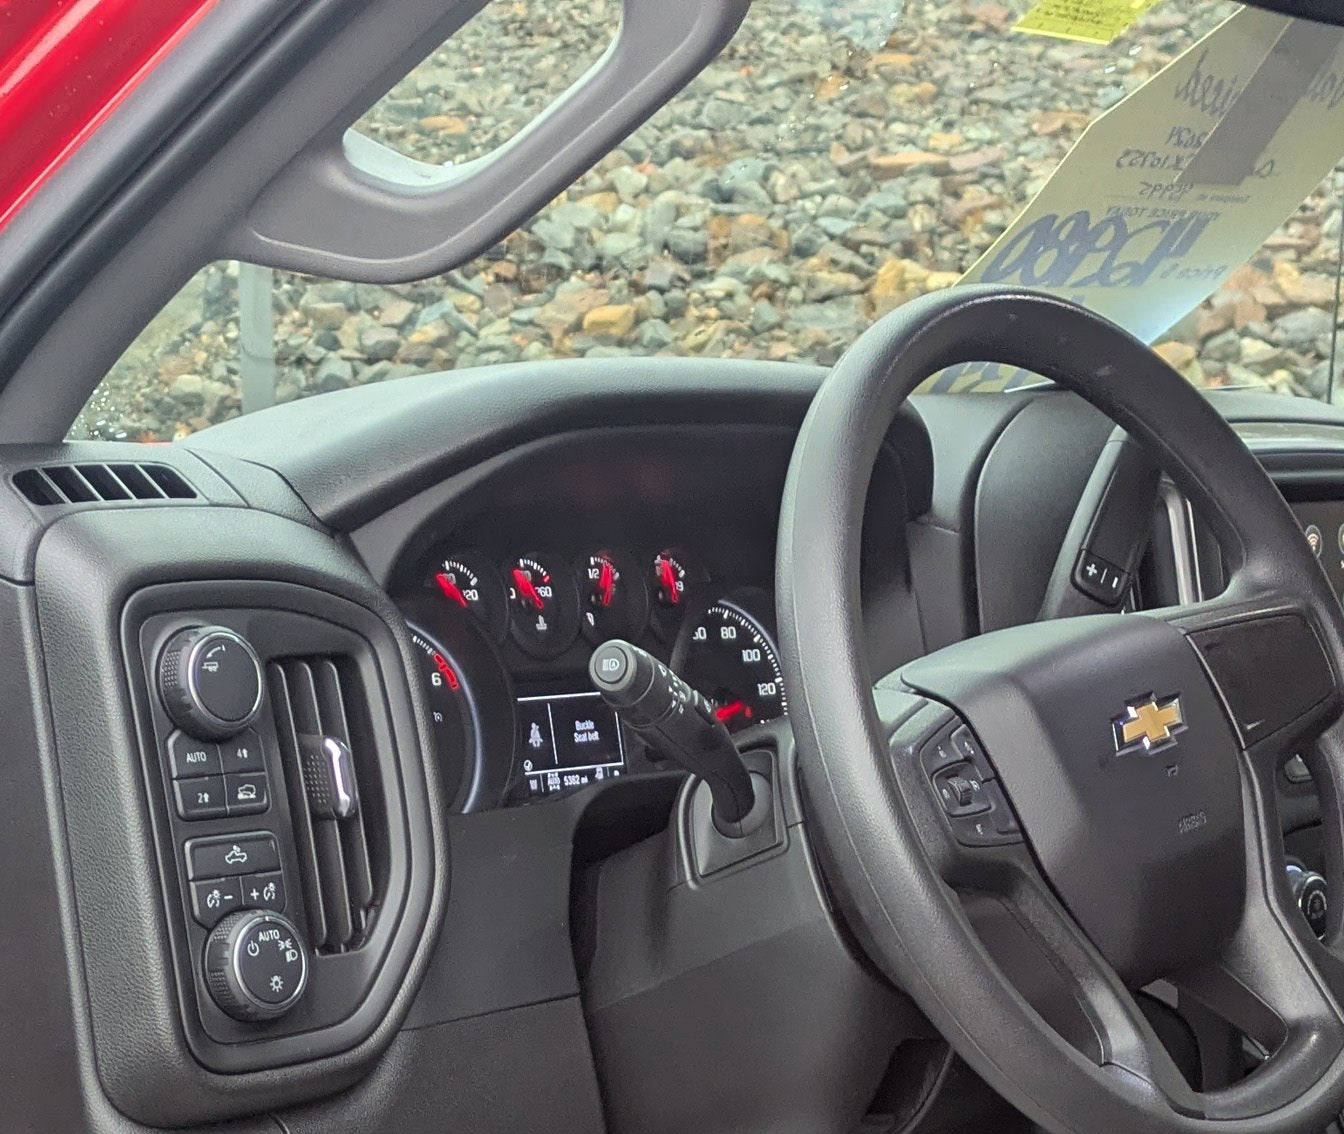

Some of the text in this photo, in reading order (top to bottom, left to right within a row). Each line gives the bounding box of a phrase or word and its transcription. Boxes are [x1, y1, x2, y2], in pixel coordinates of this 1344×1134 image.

[720, 626, 737, 640] 80
[741, 648, 761, 662] 100
[431, 672, 442, 687] 6
[757, 682, 776, 696] 120
[185, 751, 207, 763] AUTO
[258, 929, 281, 942] AUTO
